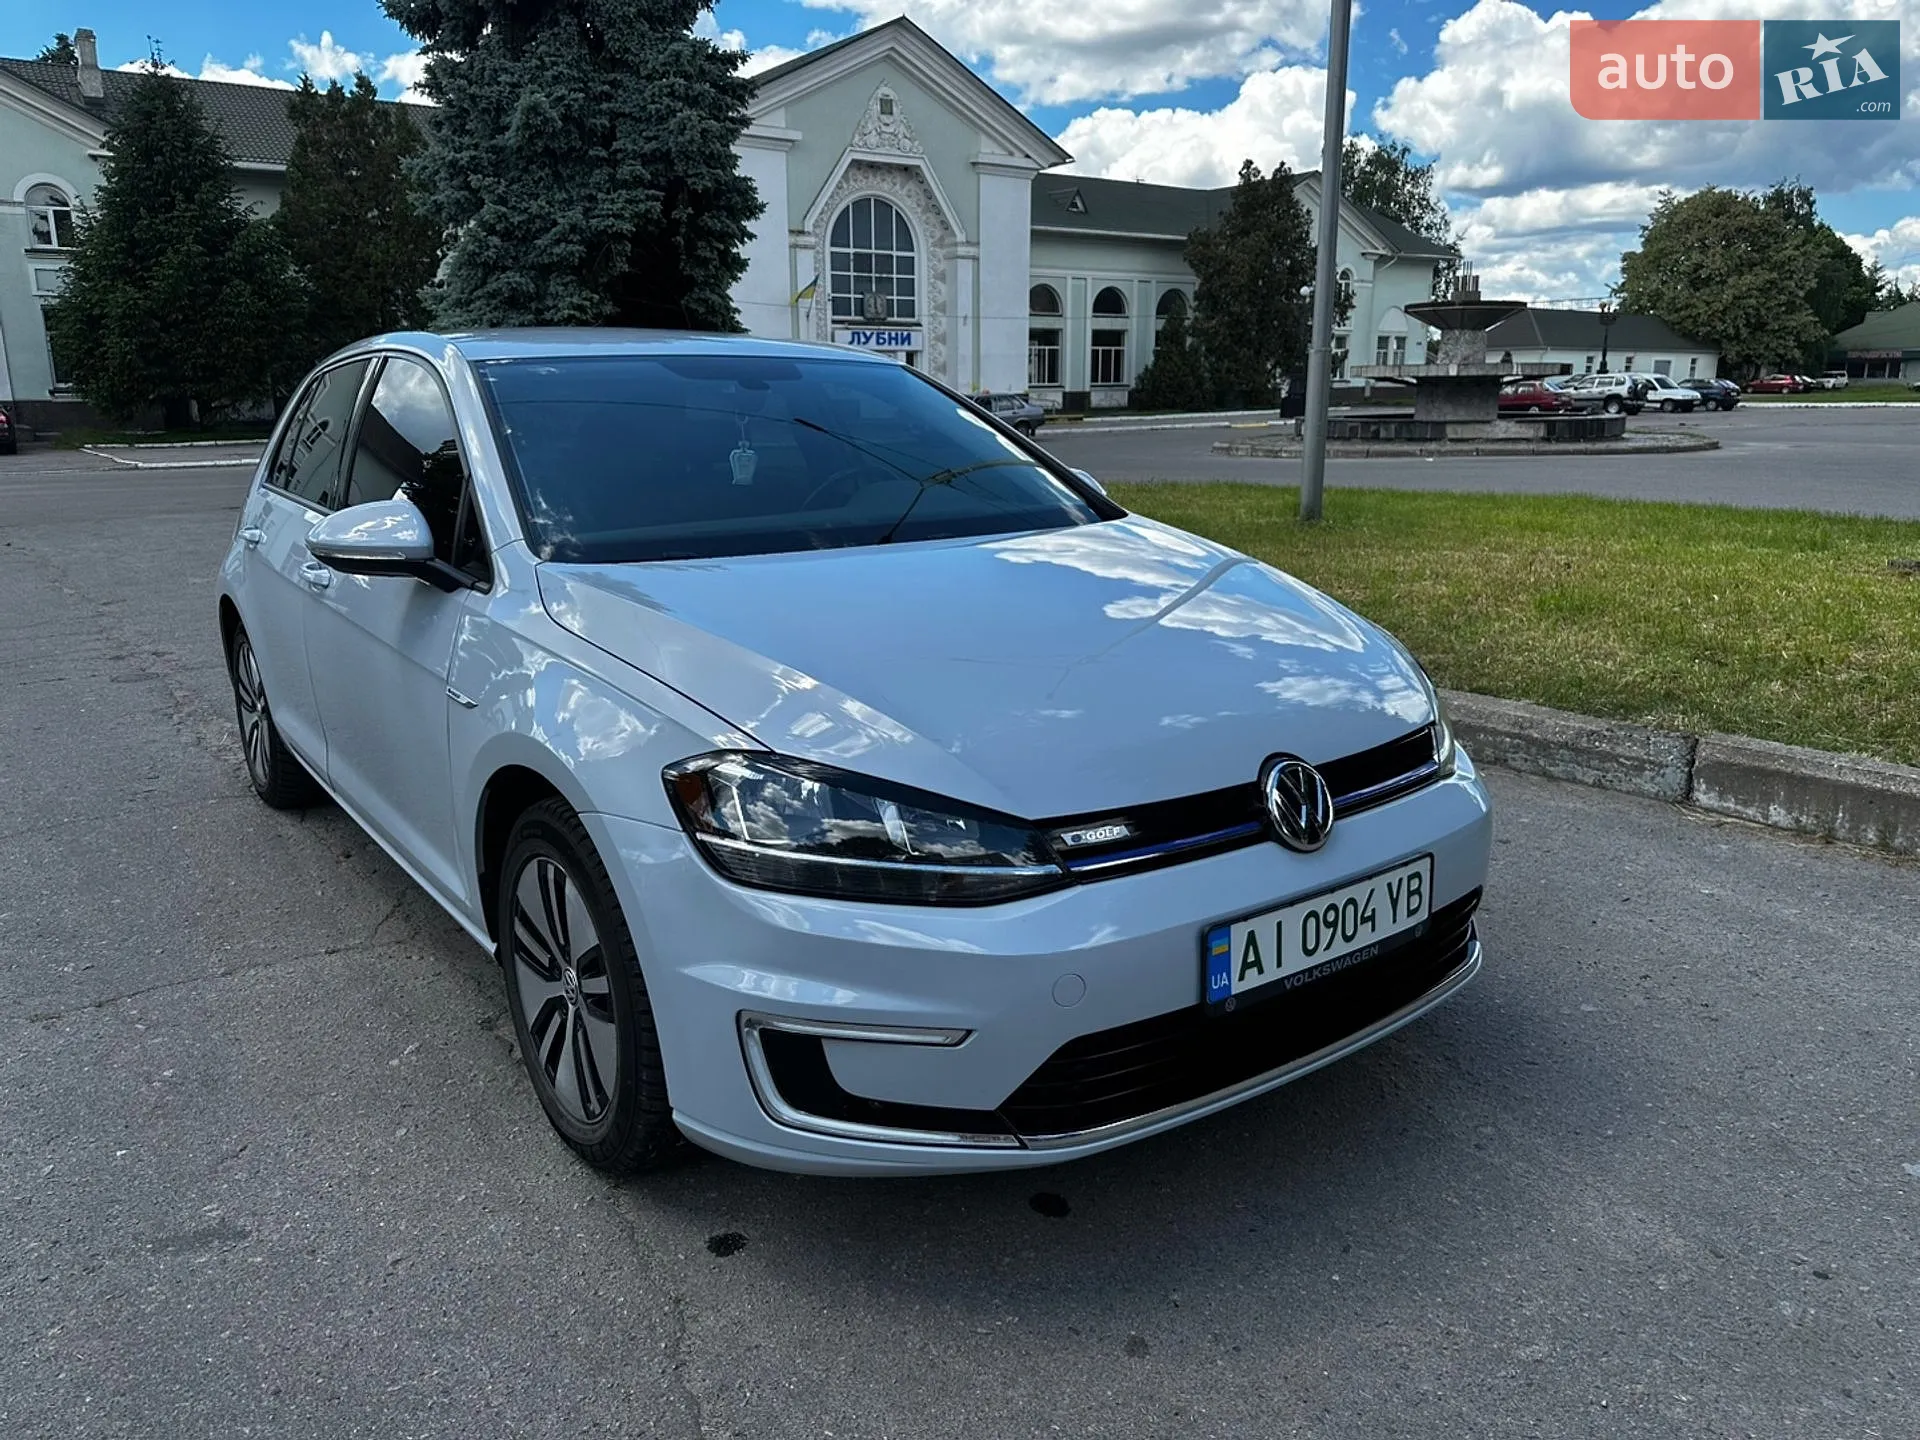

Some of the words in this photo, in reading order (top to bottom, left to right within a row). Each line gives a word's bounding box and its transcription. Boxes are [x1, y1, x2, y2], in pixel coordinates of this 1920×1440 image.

[848, 331, 912, 346] ЛУБНИ
[1238, 920, 1283, 983] AI
[1301, 888, 1376, 957] 0904
[1386, 871, 1424, 925] YB
[1211, 972, 1230, 989] UA
[1284, 945, 1380, 991] VOLKSWAGEN
